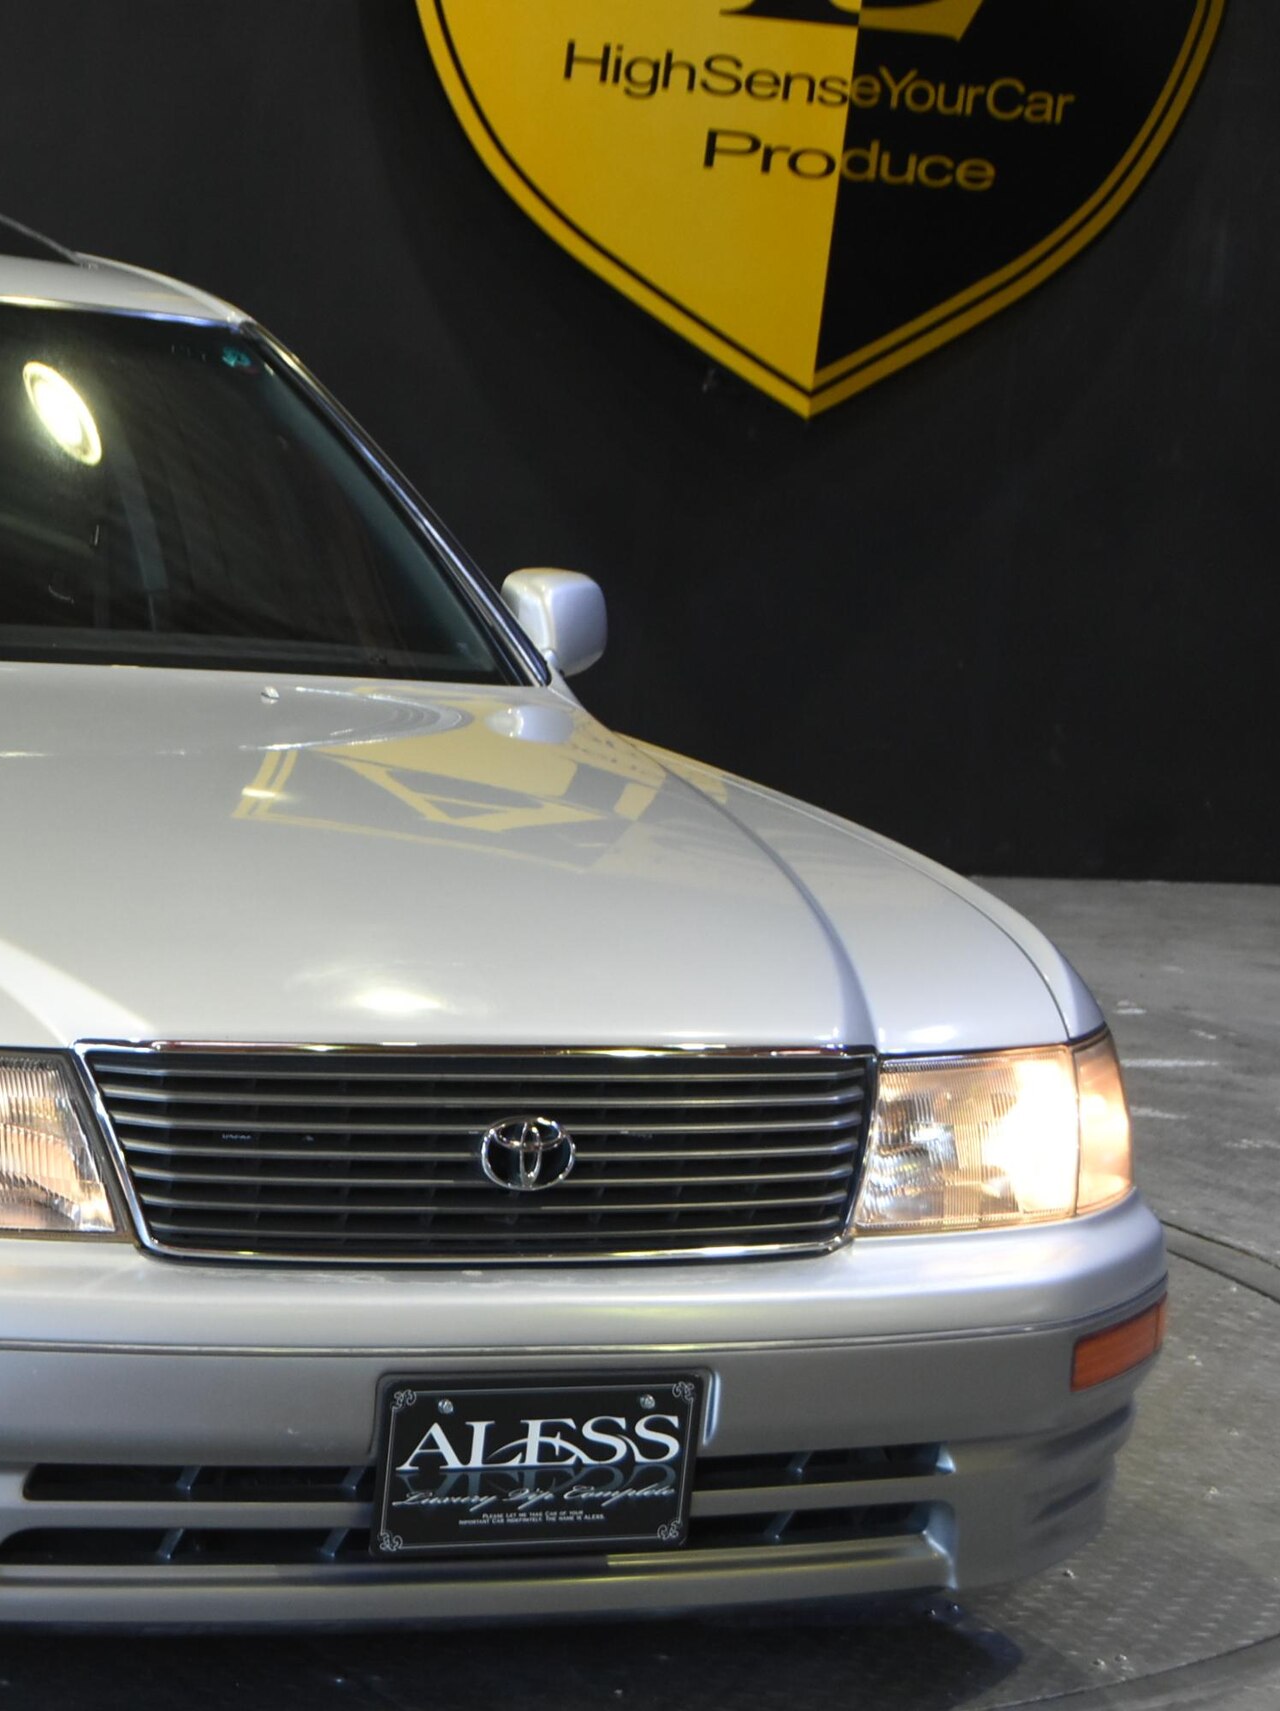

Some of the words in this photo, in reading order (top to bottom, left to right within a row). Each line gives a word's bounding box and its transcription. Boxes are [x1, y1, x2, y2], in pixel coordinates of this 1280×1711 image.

[563, 40, 1075, 125] HighSenseYourCar
[702, 128, 997, 192] Produce
[395, 1415, 680, 1471] ALESS
